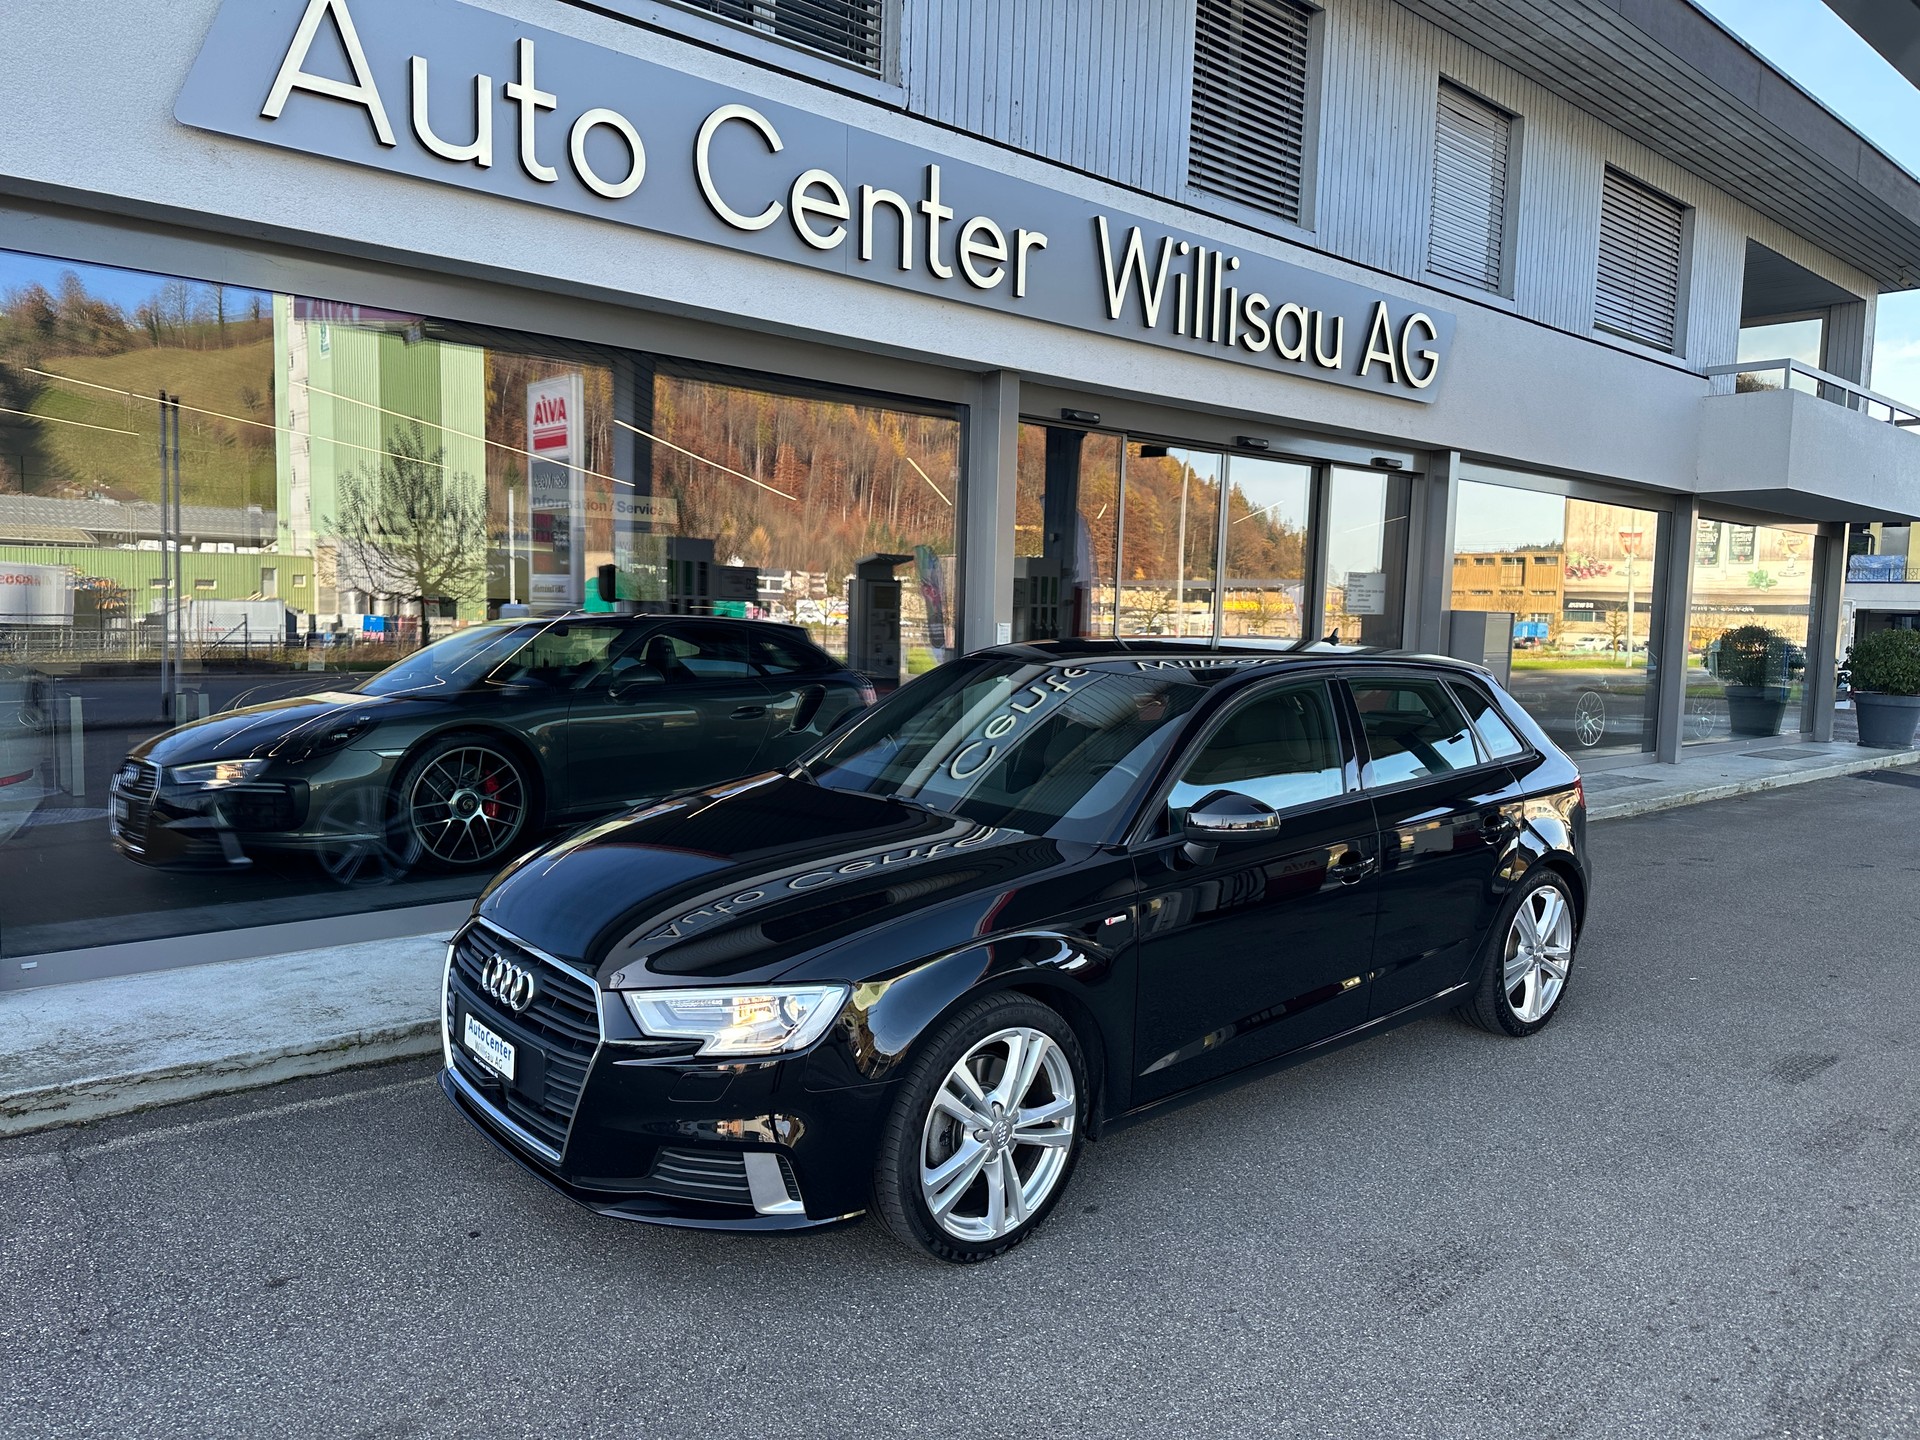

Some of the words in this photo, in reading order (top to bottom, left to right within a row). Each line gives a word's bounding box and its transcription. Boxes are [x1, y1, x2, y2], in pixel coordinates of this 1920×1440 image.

[259, 0, 647, 199] Auto
[692, 103, 1048, 299] Center
[1094, 215, 1344, 370] Willisau
[1357, 300, 1440, 390] AG
[529, 494, 608, 513] nformation
